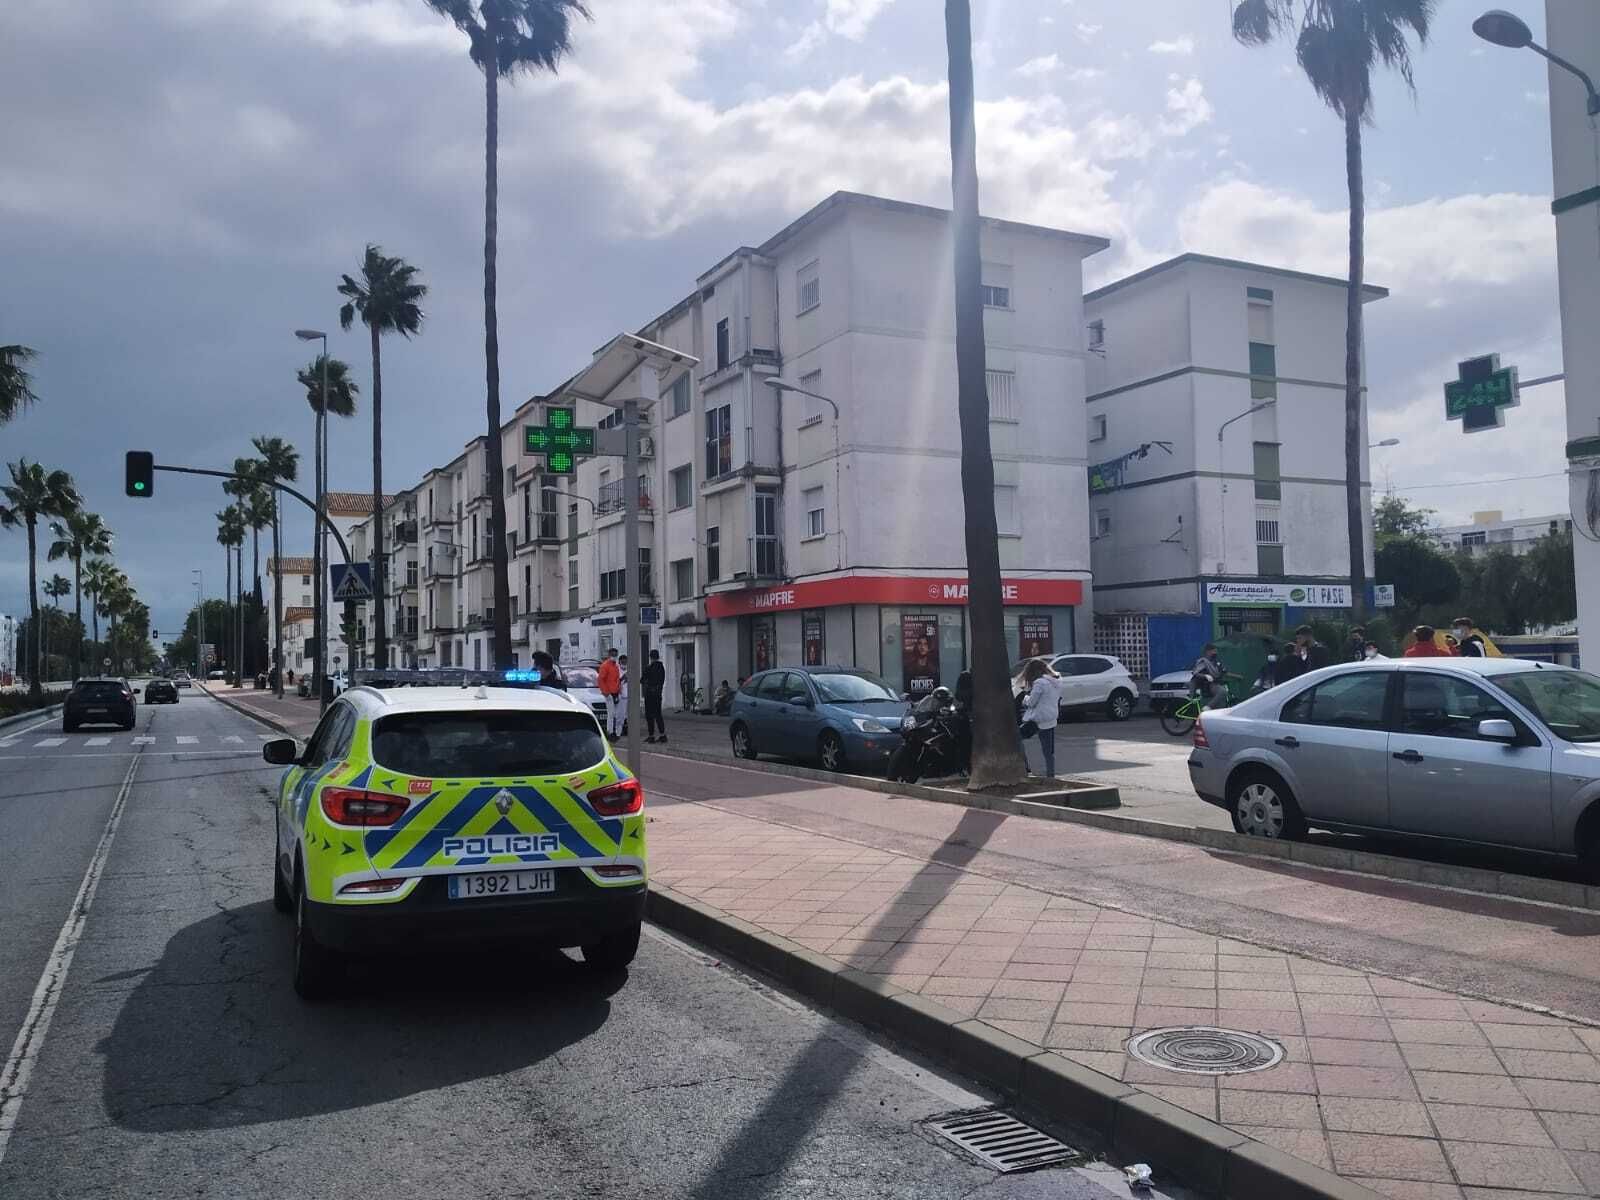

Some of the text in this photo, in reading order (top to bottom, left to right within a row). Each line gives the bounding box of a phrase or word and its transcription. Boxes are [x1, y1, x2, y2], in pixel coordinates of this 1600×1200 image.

[942, 584, 1018, 600] MAE
[1209, 583, 1274, 594] Alimentación
[756, 590, 795, 608] MAPFRE
[444, 835, 558, 857] POLICIA
[464, 871, 550, 895] 1392 LJH
